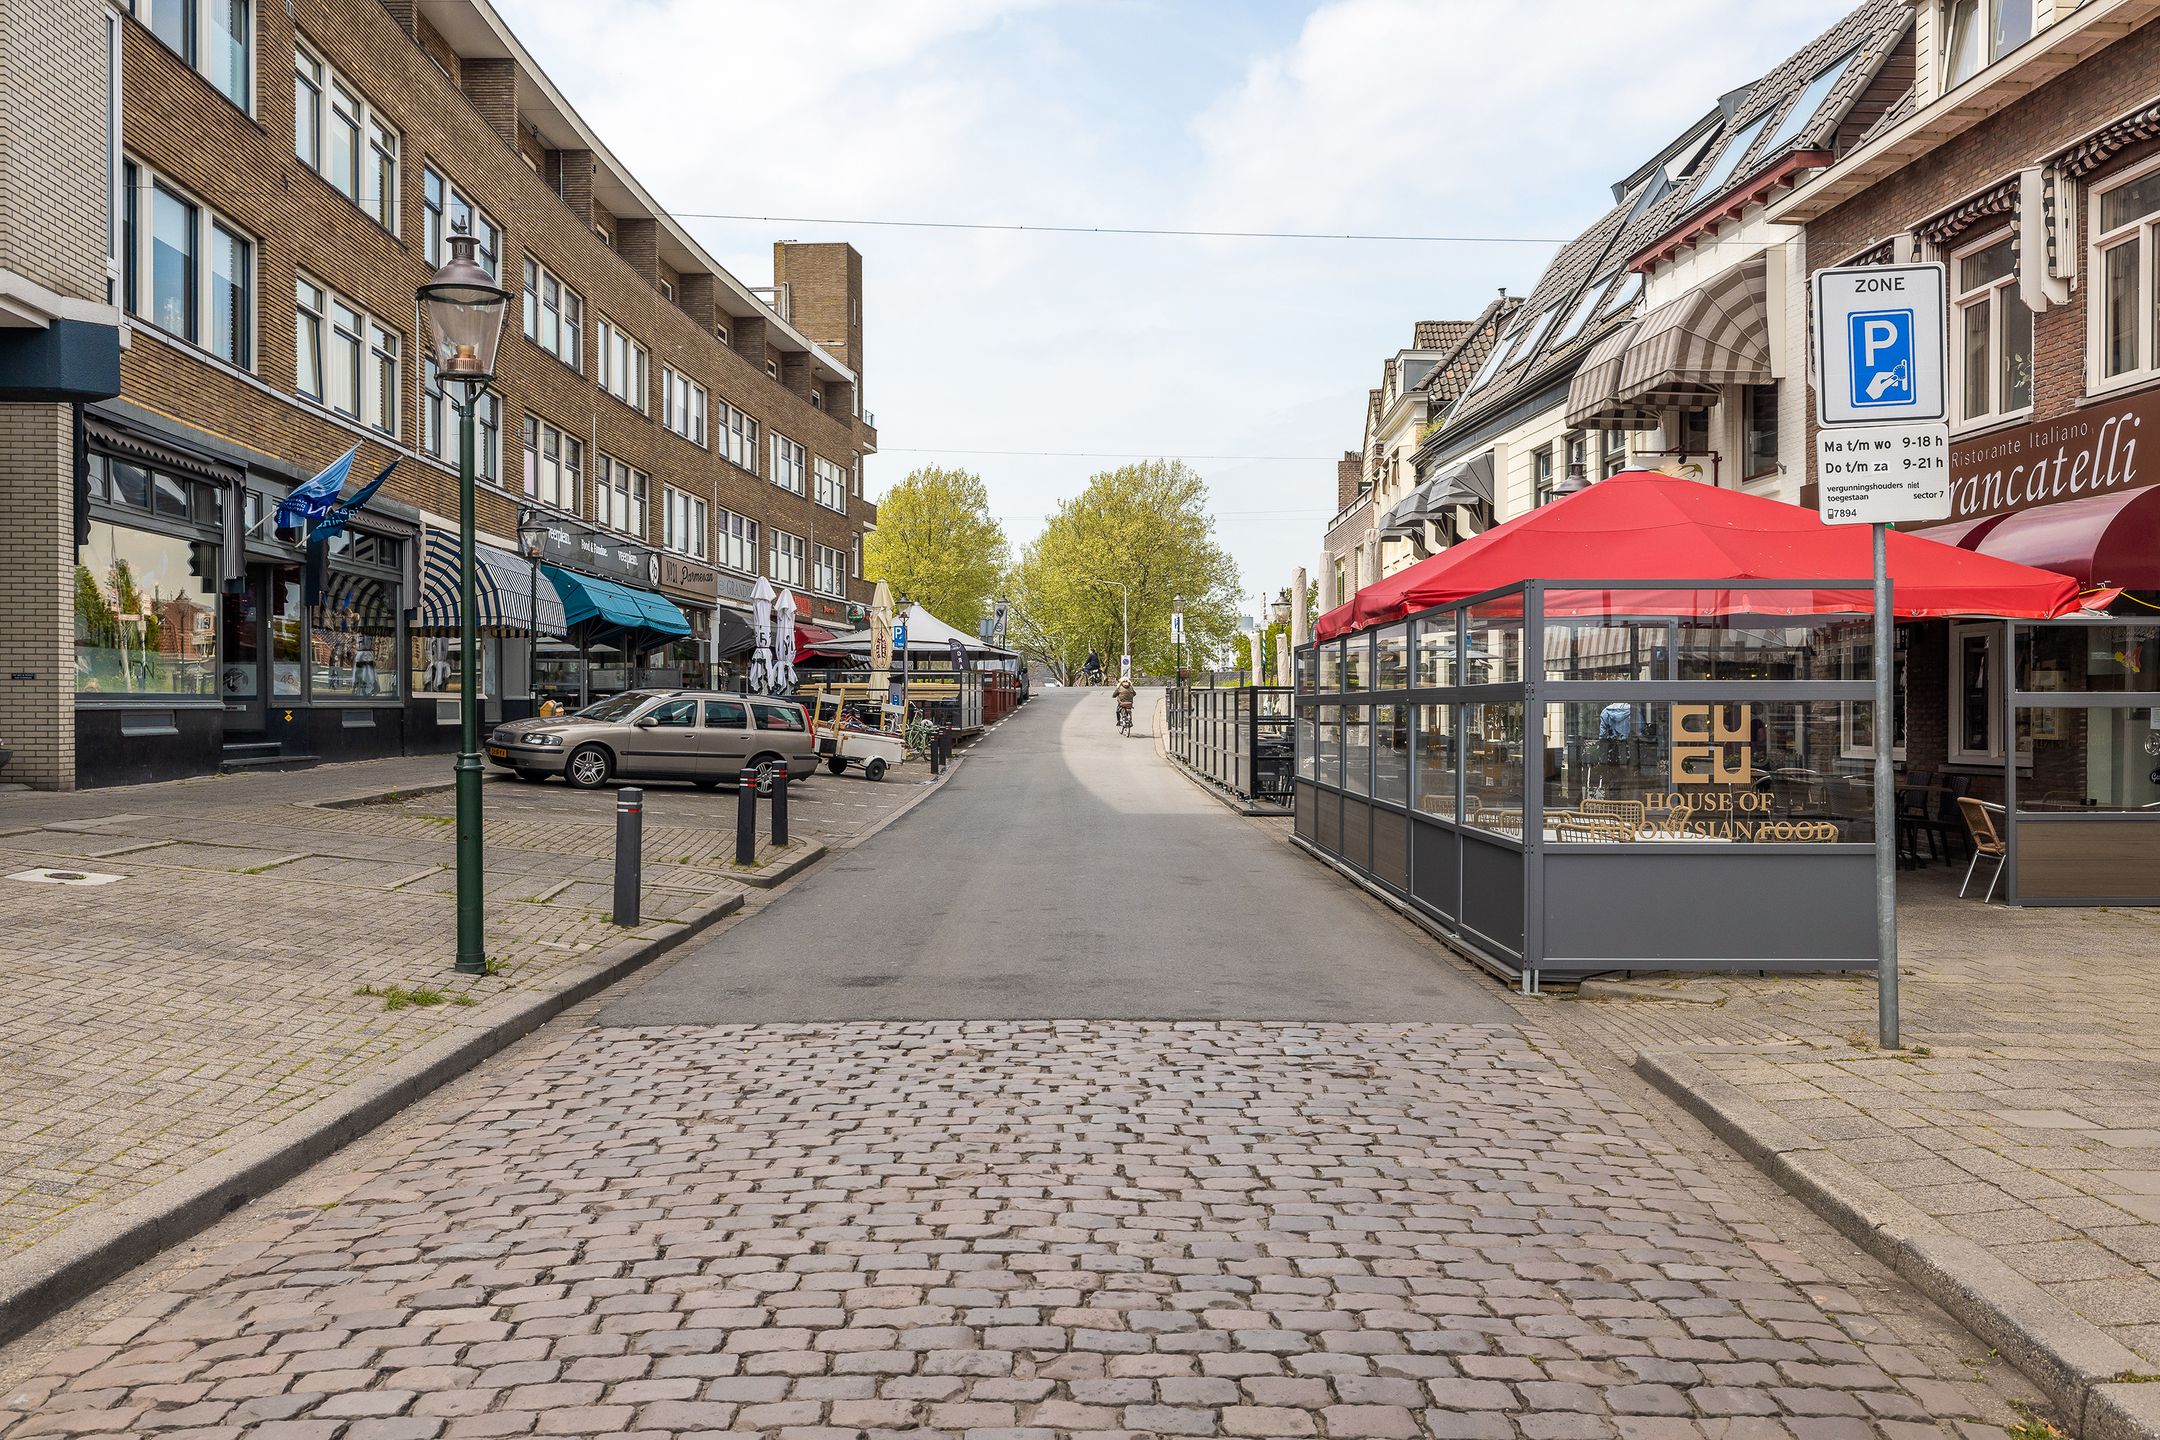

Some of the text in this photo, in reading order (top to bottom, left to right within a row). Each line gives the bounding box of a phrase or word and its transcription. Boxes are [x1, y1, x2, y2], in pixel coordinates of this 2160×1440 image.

[1855, 277, 1905, 293] ZONE
[1864, 320, 1898, 367] P
[1824, 435, 1943, 452] Ma t/m wo 9-18 h
[1951, 422, 2088, 468] Ristorante Italiano
[1825, 457, 1944, 473] Do t/m za 9-21 h
[1949, 412, 2141, 518] rancatelli
[1827, 481, 1920, 493] vergunningshouders niet
[1827, 490, 1944, 503] toegestaan sector 7
[1833, 508, 1857, 518] 7894
[680, 565, 714, 586] Parmesan
[1645, 791, 1775, 812] HOUSE OF
[1590, 820, 1836, 841] INDONESIAN FOOD
